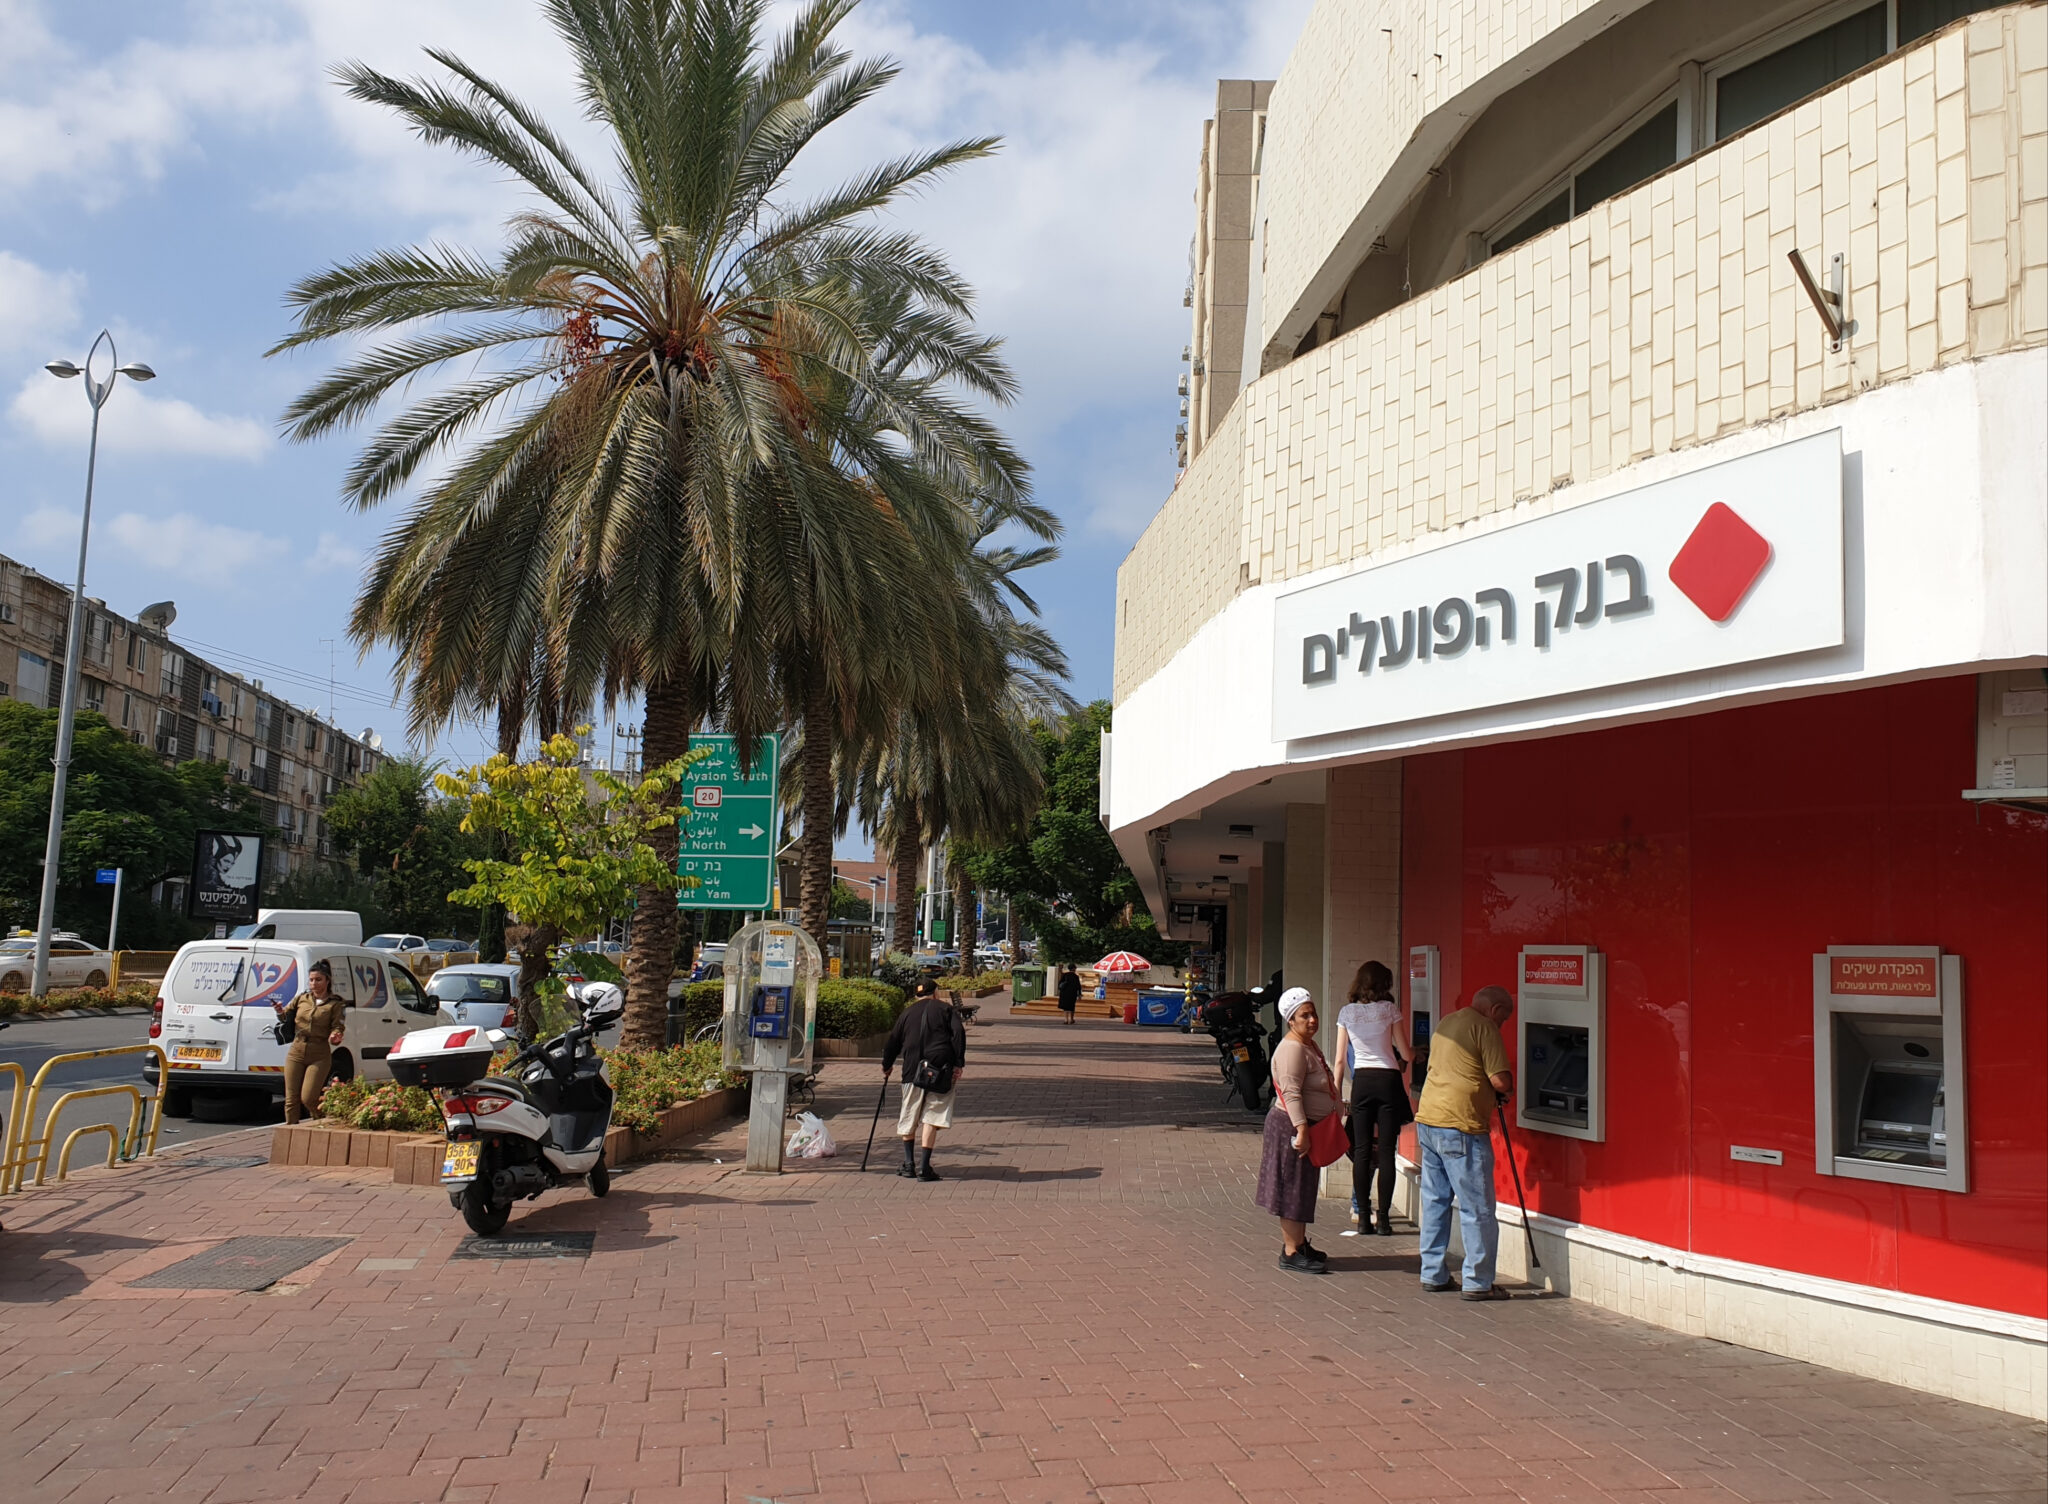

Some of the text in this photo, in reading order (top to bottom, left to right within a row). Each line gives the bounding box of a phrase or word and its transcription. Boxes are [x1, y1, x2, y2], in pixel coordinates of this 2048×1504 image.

[1302, 554, 1650, 686] בנק הפועלים
[686, 771, 727, 783] Ayalon
[701, 792, 714, 801] 20
[687, 809, 719, 824] איילון
[692, 840, 727, 850] North
[686, 861, 722, 871] בת ים
[199, 890, 248, 906] מליפיסנט
[706, 889, 731, 899] Yam
[251, 961, 282, 988] כץ
[1842, 963, 1924, 978] הפקדת שיקים
[354, 964, 377, 993] כץ
[1836, 980, 1867, 990] ופעולות
[1868, 982, 1888, 990] מידע
